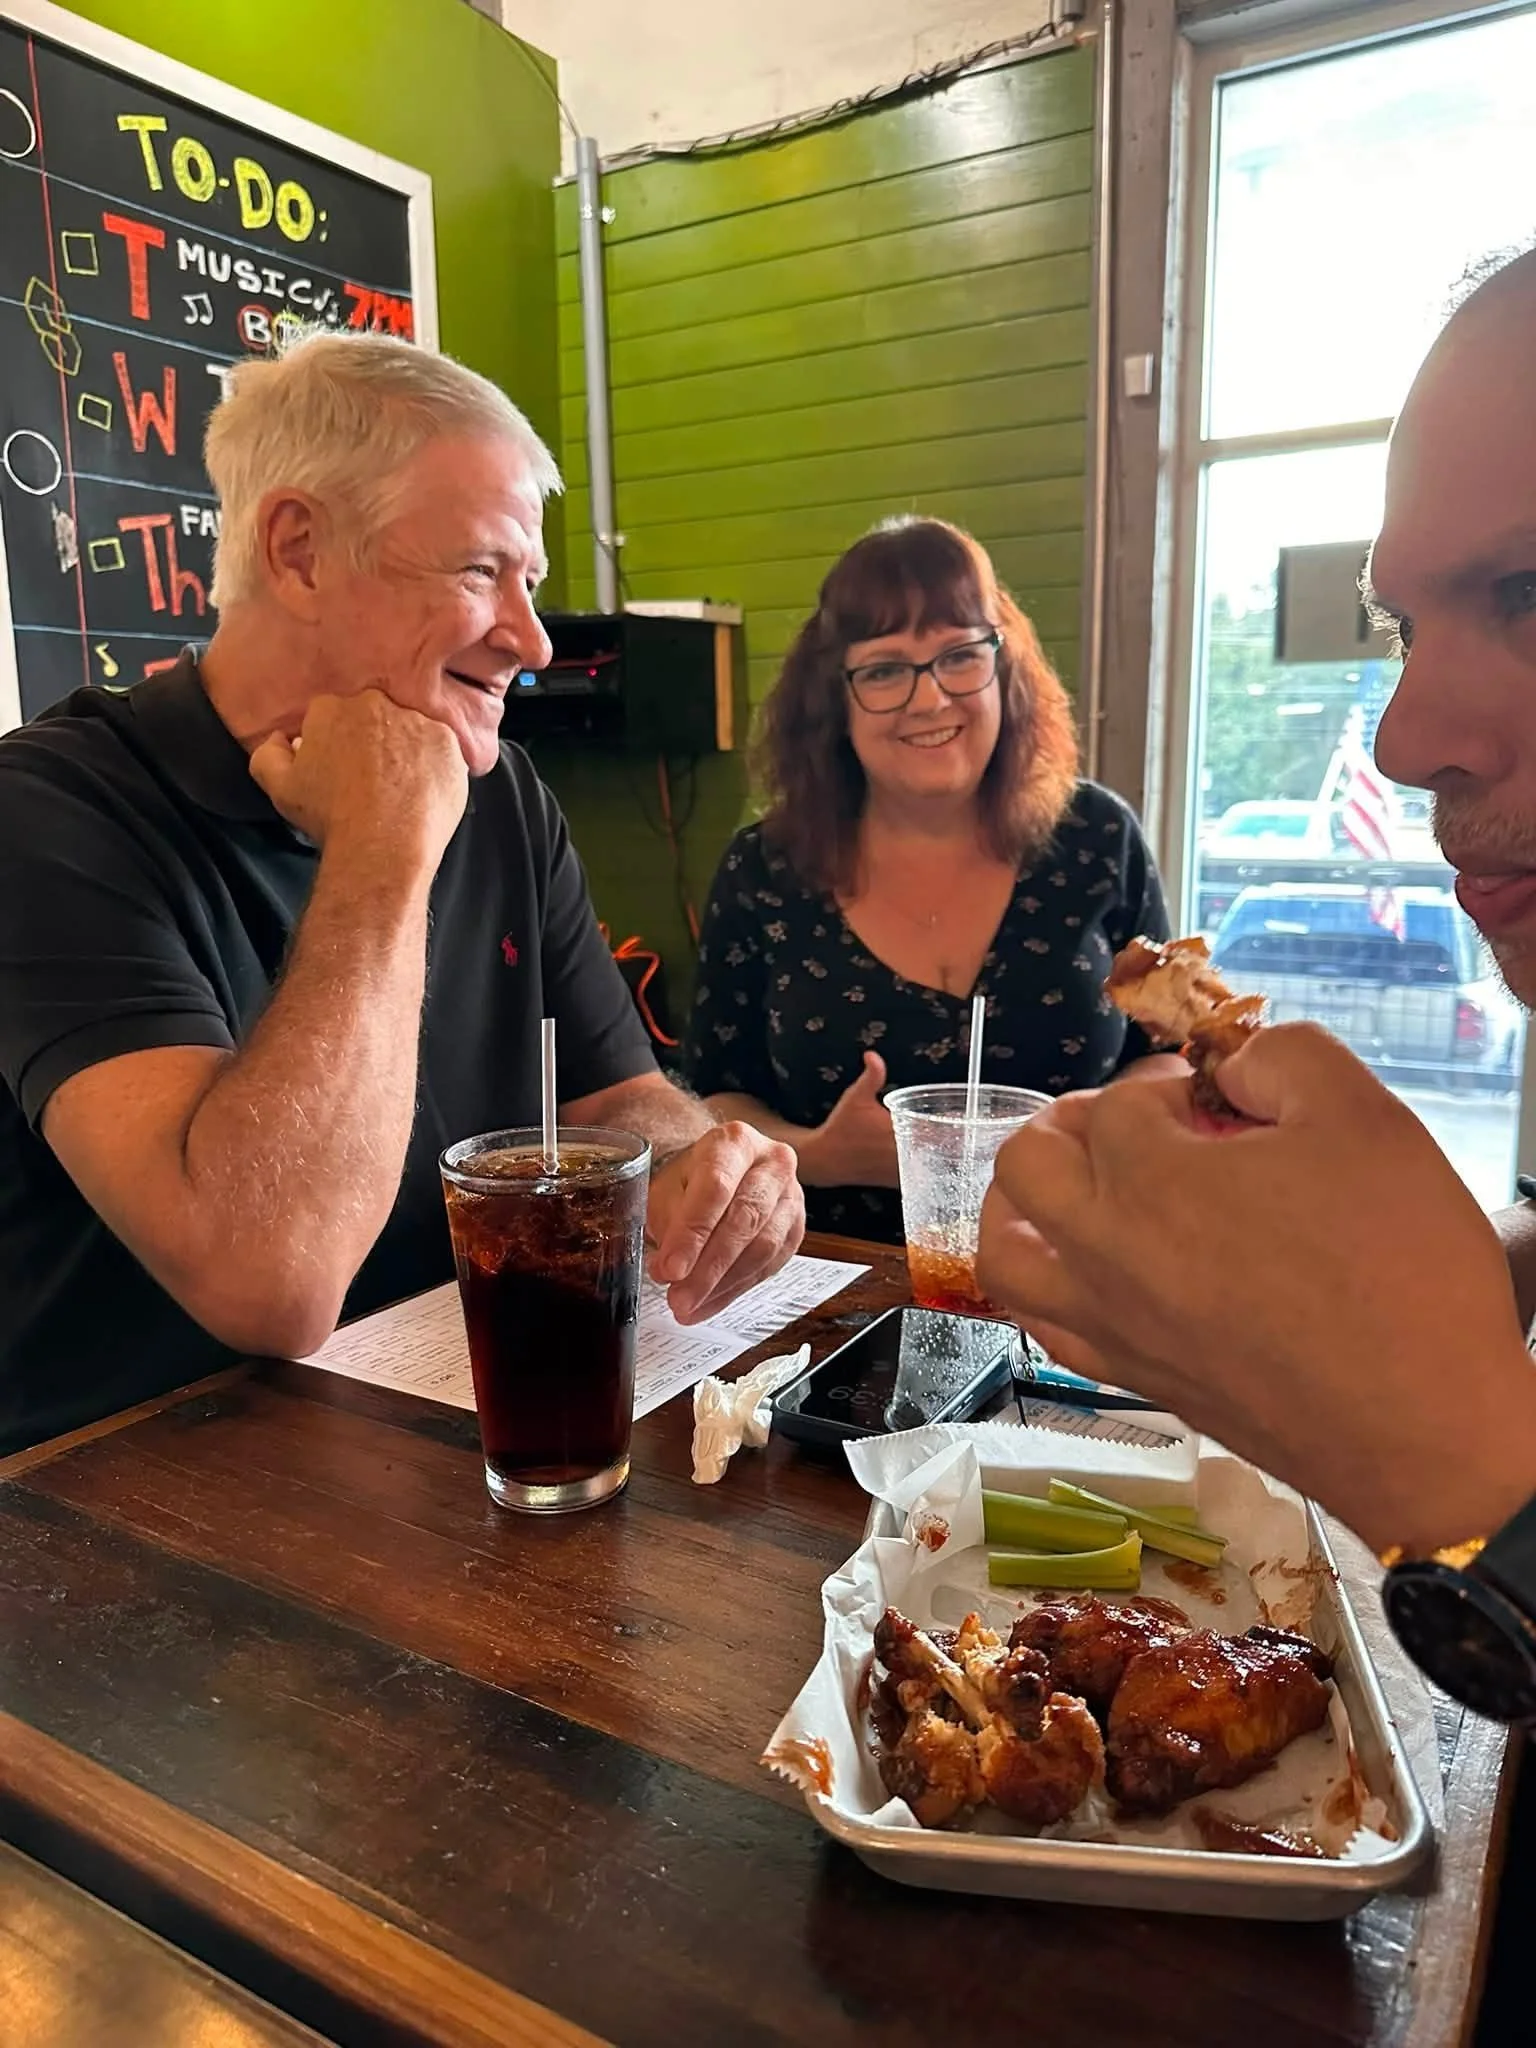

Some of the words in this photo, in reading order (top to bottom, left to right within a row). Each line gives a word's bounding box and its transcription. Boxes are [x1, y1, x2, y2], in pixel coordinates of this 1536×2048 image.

[103, 212, 165, 321] T
[177, 237, 313, 305] MUSIC
[113, 352, 176, 456] W
[117, 513, 206, 616] Th
